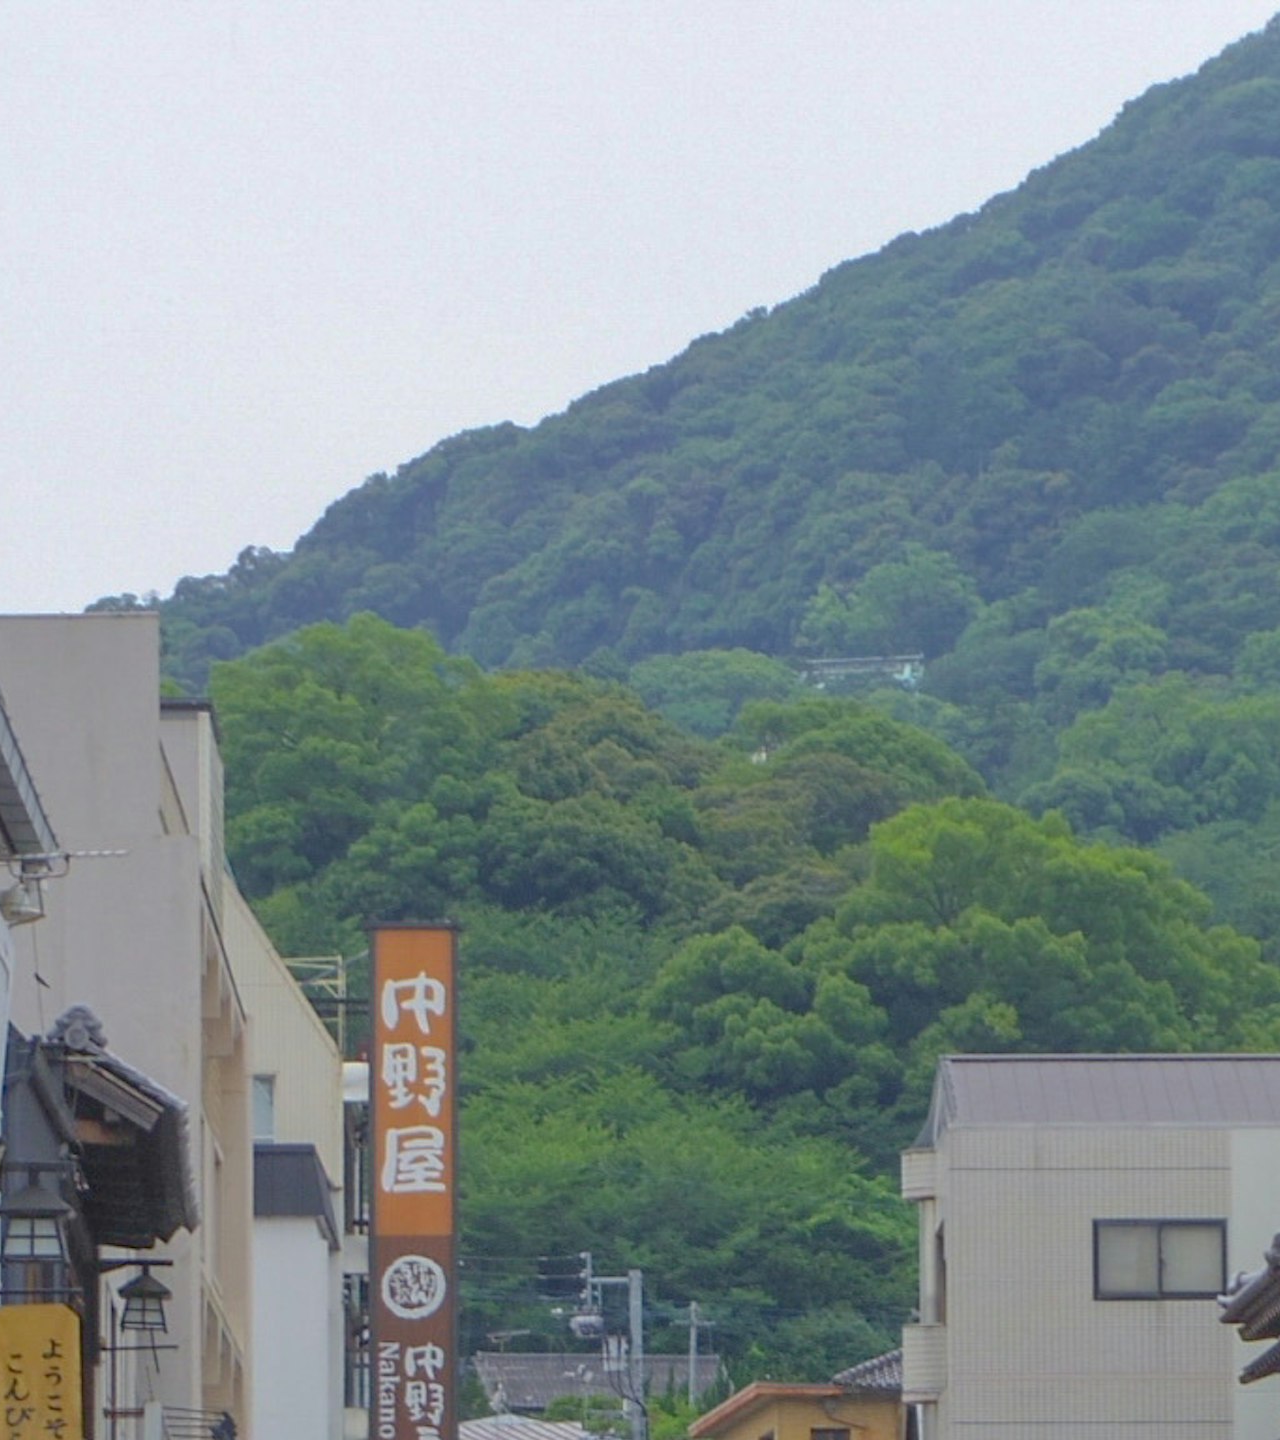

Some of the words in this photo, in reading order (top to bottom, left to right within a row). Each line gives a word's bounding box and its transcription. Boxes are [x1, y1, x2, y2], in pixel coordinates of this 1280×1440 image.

[381, 971, 447, 1193] 中野屋
[42, 1339, 67, 1440] ようこそ
[378, 1341, 400, 1439] Nakano
